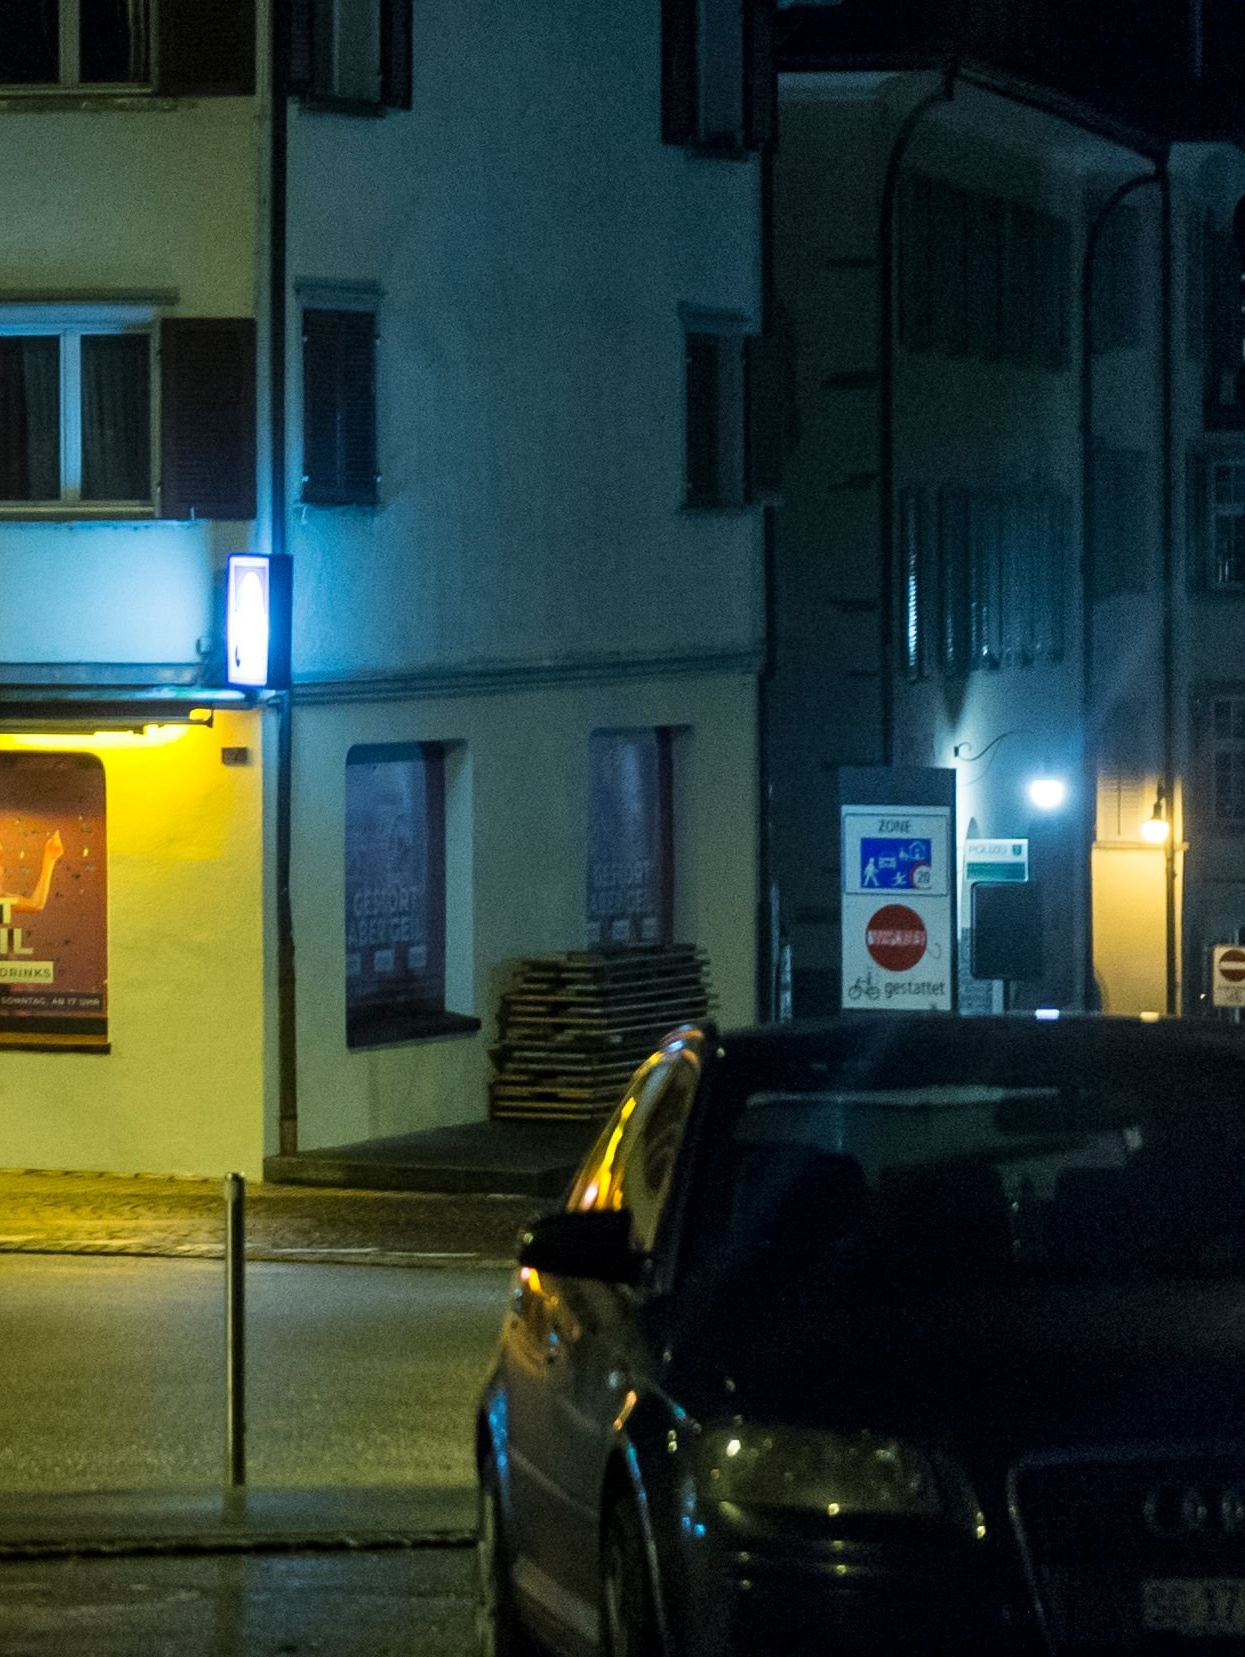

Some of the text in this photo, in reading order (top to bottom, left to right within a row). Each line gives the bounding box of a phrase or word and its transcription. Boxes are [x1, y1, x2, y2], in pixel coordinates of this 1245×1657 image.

[877, 819, 911, 834] ZONE
[918, 872, 930, 883] 20
[884, 981, 945, 998] gestattet
